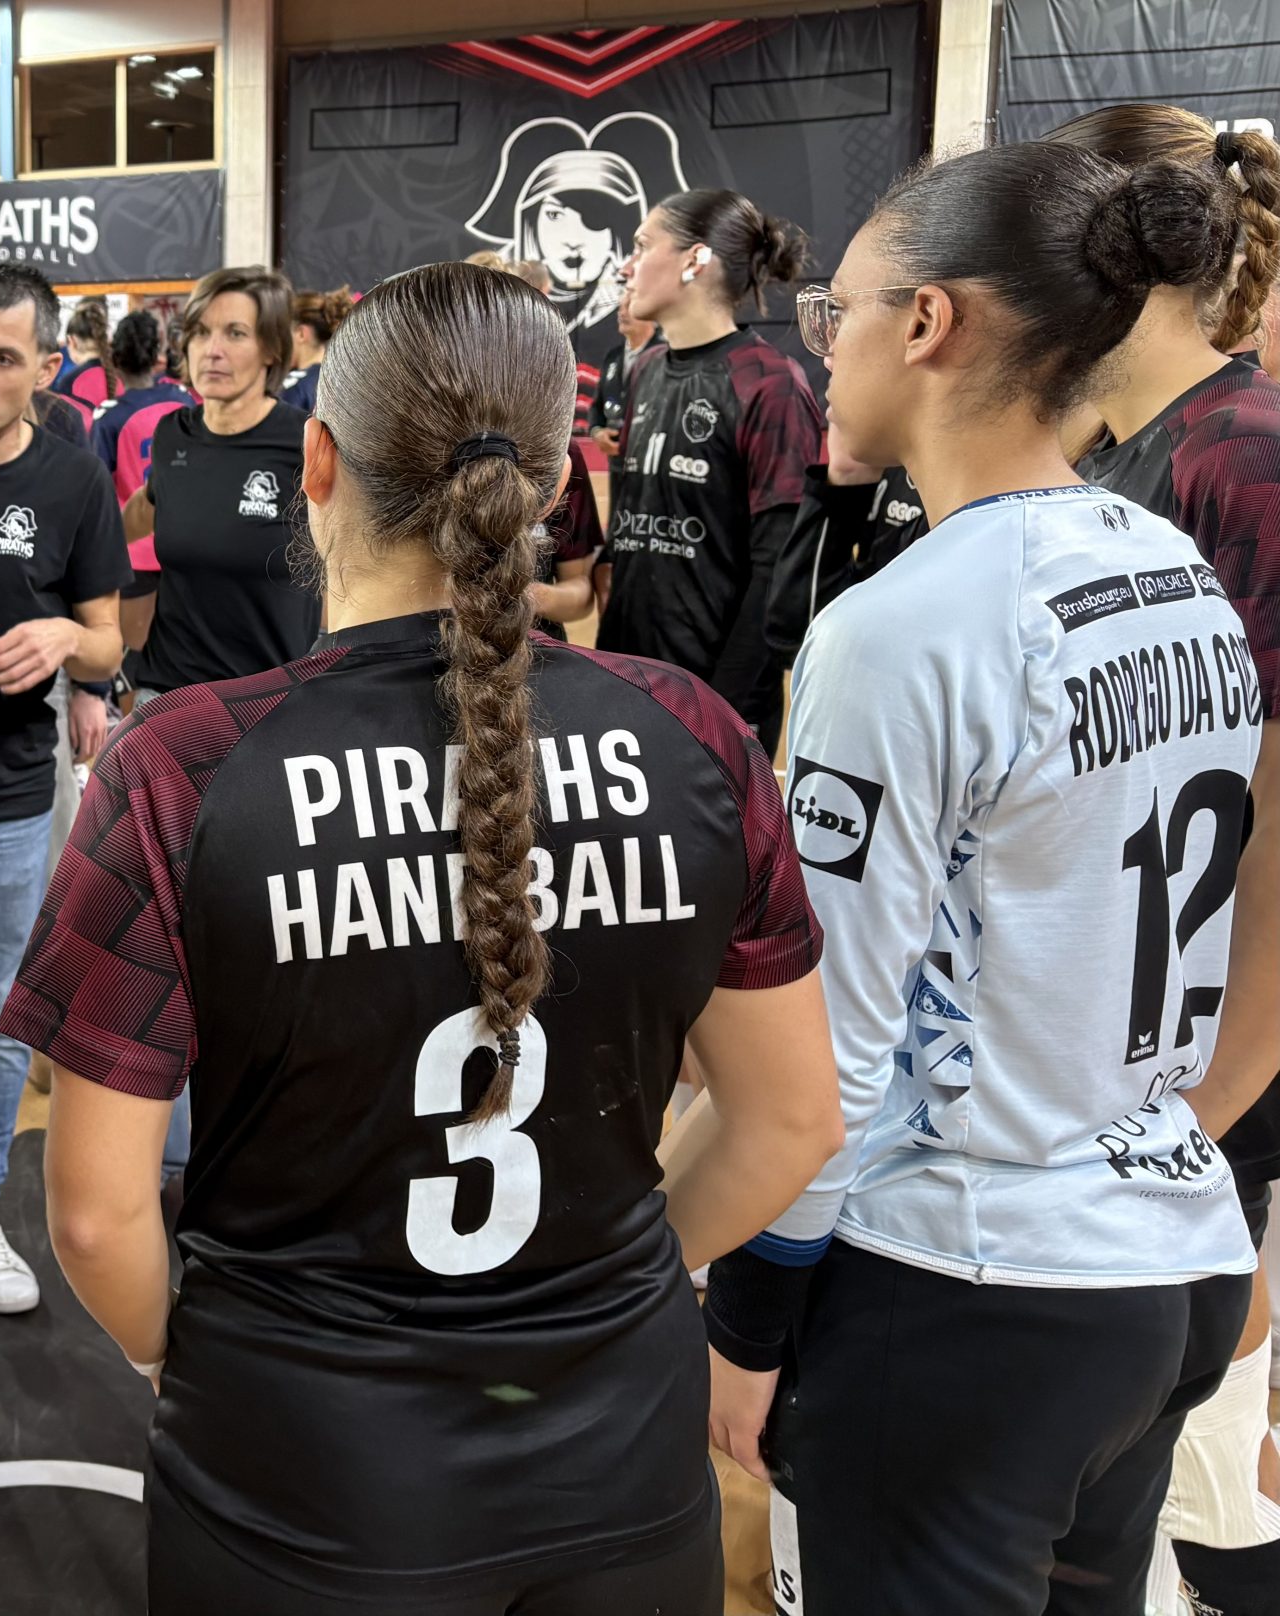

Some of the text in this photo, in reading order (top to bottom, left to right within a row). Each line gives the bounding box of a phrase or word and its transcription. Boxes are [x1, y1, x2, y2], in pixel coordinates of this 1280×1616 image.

[1156, 572, 1191, 592] ALSACE
[1172, 638, 1215, 739] DA
[284, 728, 650, 847] PIRHS
[1122, 768, 1249, 1066] 12
[1131, 1043, 1155, 1059] erima
[405, 1003, 548, 1276] 3
[1139, 1184, 1213, 1200] TECHNOLOGIES
